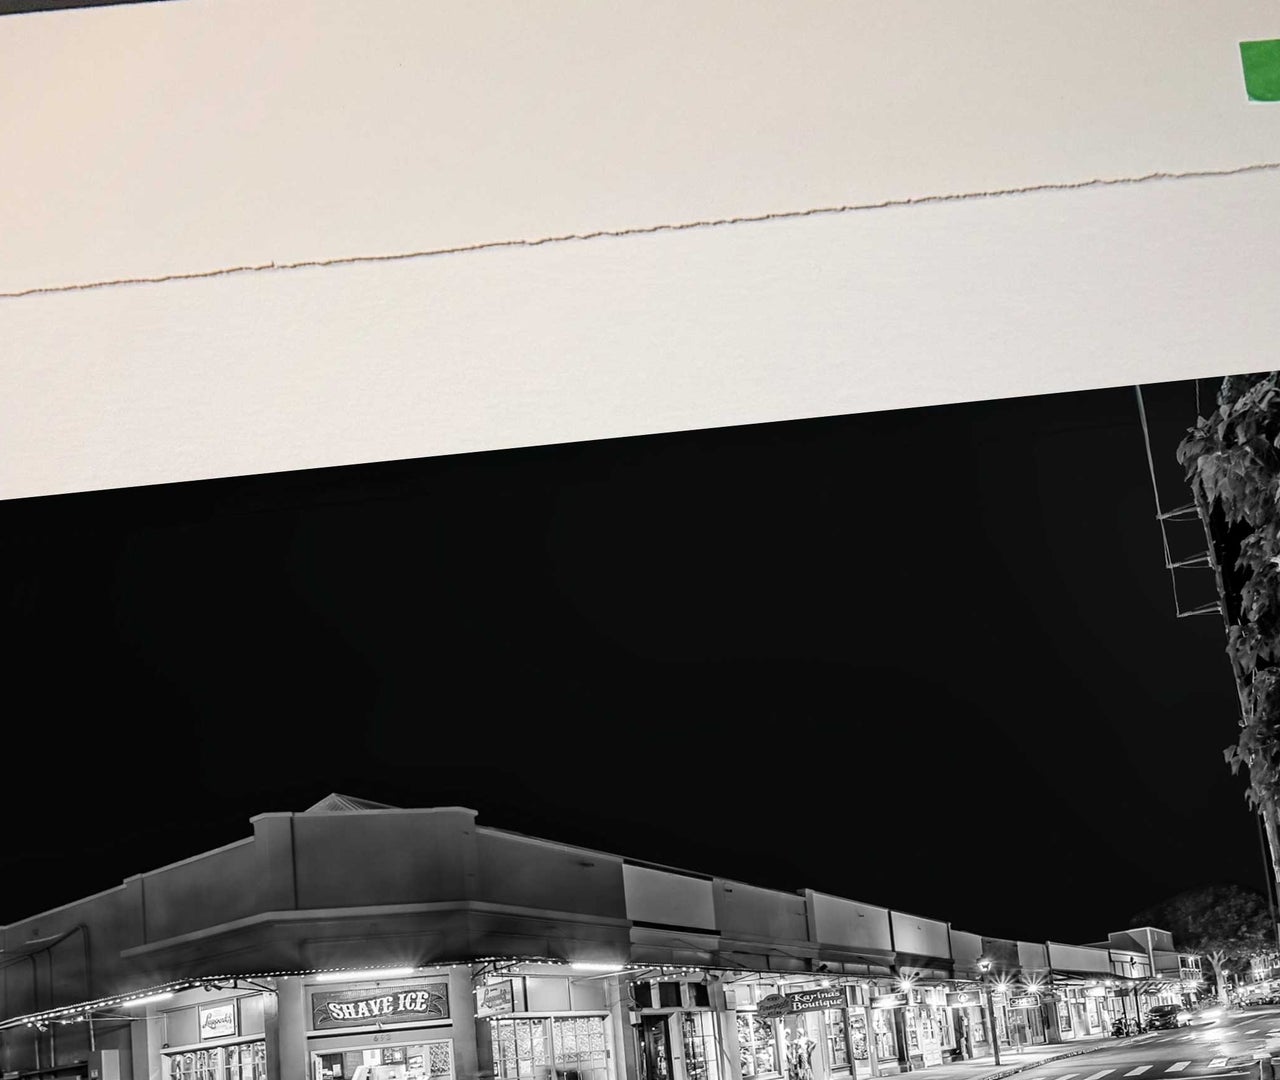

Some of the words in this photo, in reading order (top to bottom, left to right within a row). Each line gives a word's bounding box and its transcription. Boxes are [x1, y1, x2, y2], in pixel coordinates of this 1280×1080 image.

[328, 996, 394, 1019] SHAVE
[397, 991, 430, 1011] ICE
[792, 998, 843, 1011] Boutique
